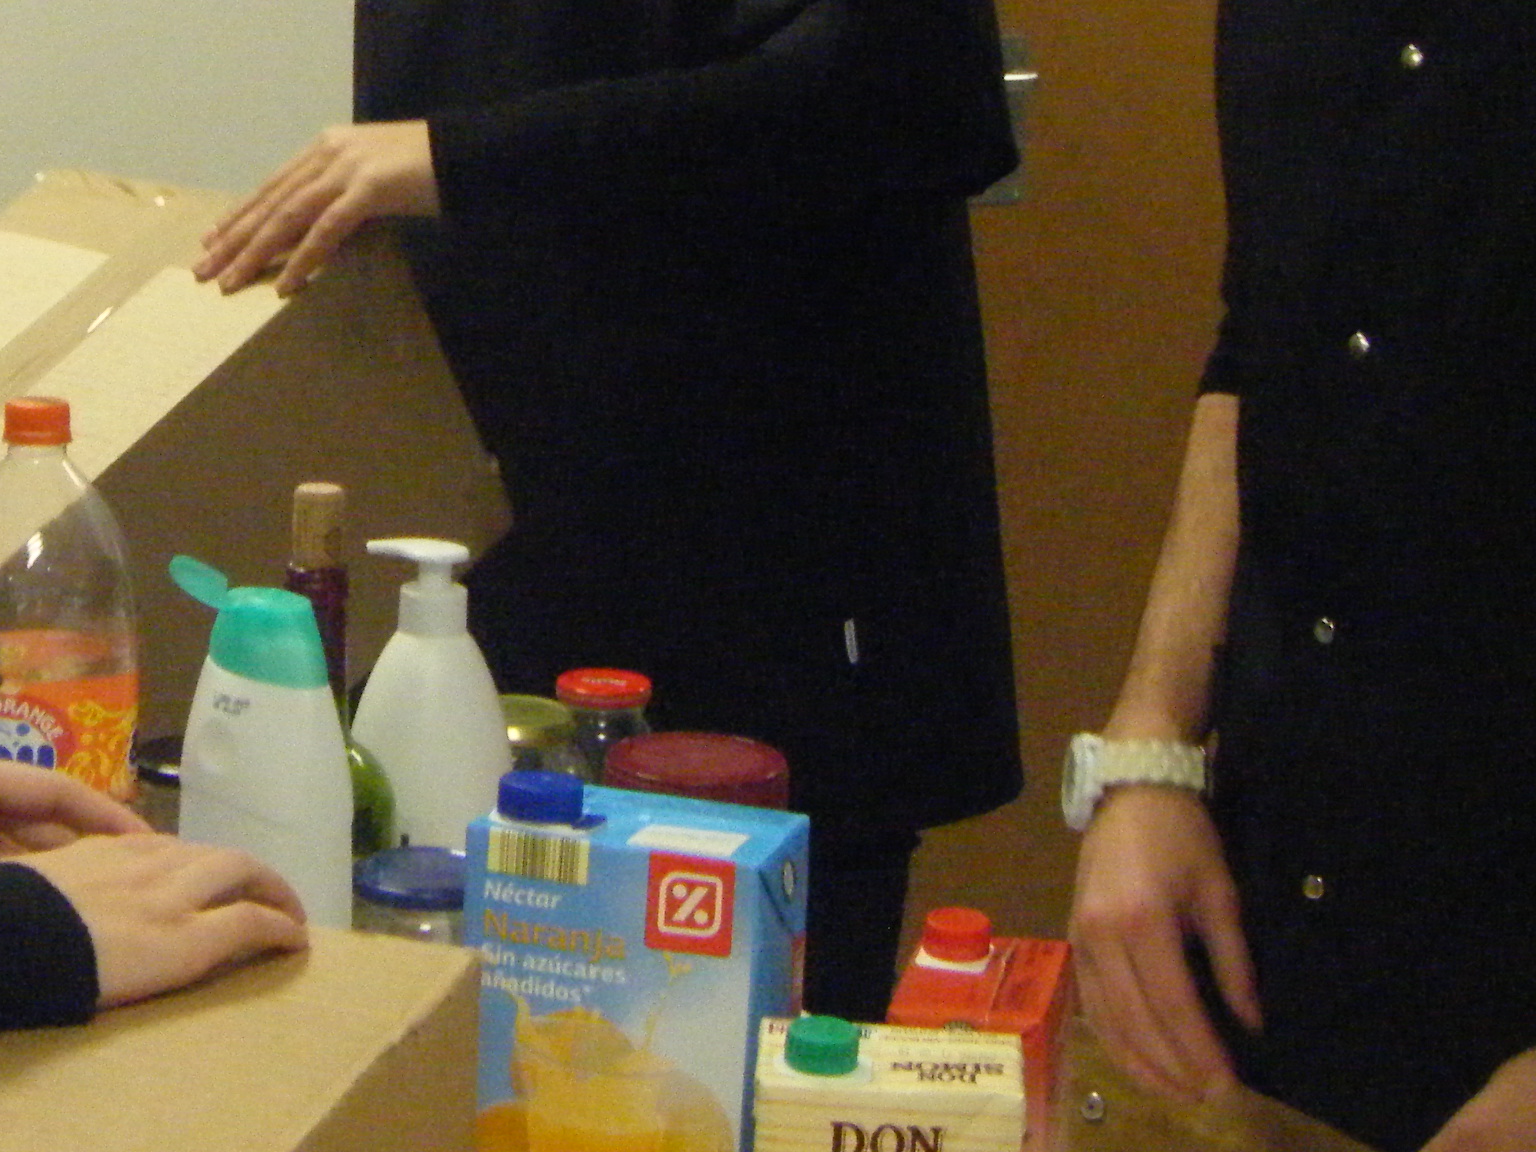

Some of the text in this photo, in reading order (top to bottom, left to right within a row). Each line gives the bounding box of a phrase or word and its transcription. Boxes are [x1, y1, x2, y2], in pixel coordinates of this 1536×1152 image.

[483, 879, 563, 910] Néctar
[482, 908, 627, 964] Naranja
[522, 953, 626, 985] azúcares
[830, 1120, 946, 1152] DON
